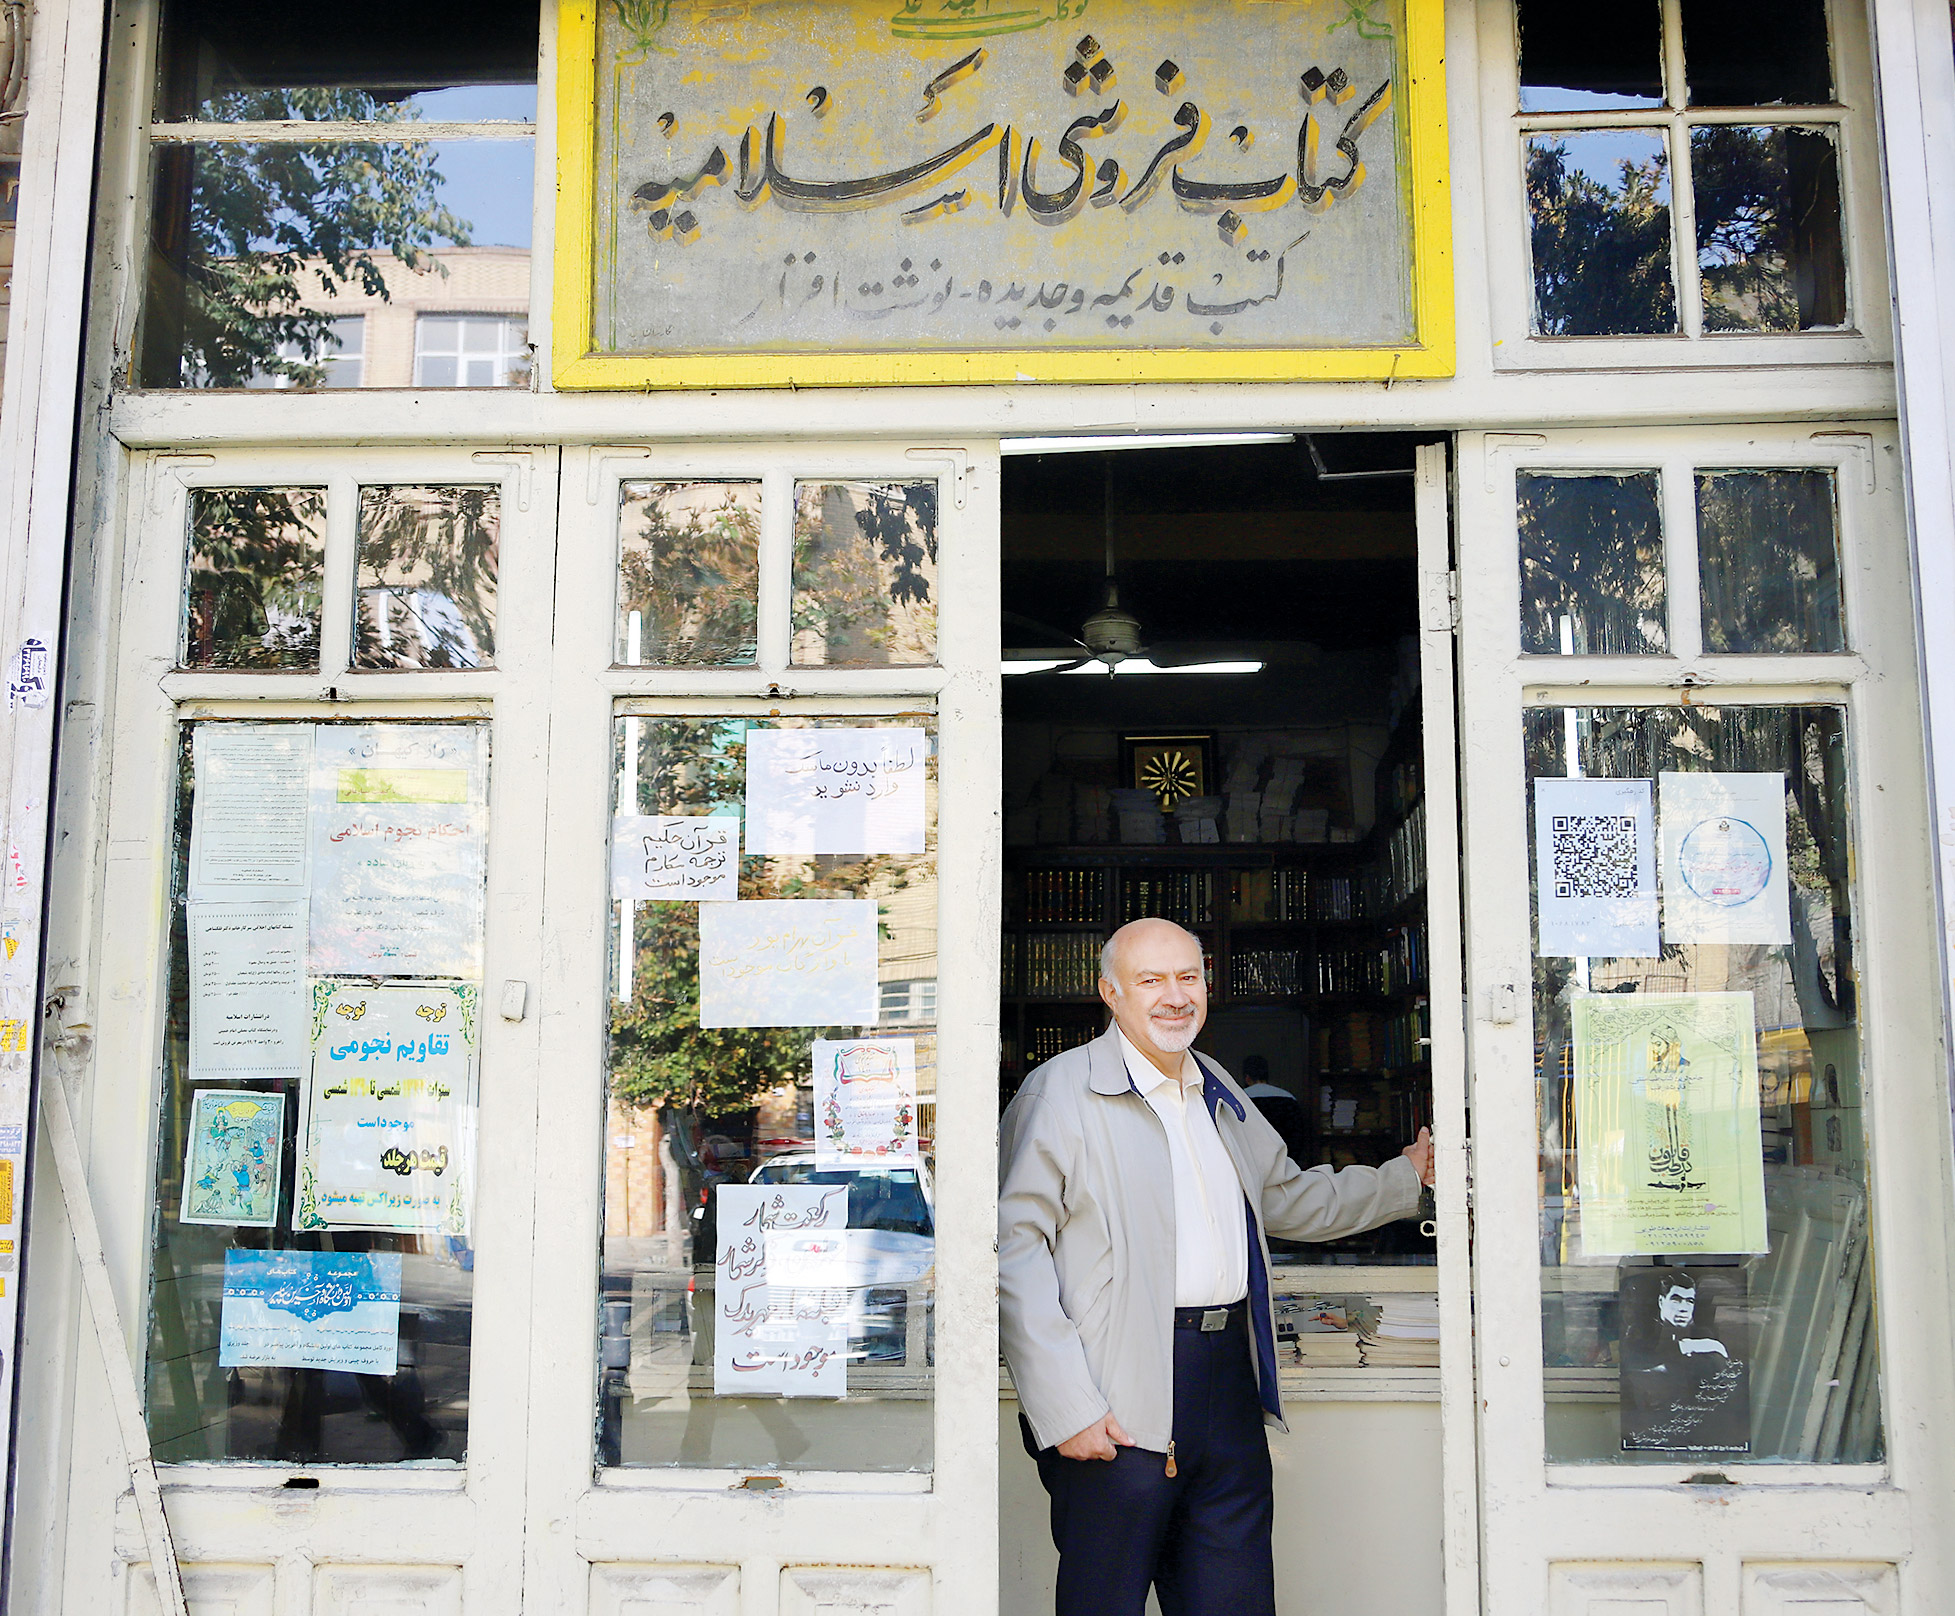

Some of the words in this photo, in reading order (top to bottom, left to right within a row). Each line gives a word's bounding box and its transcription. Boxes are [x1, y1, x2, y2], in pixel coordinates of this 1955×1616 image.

[1021, 34, 1211, 226] فروشی
[628, 86, 1020, 247] اسلامیه
[1173, 66, 1391, 246] کتاب
[736, 251, 841, 324] افزار
[845, 257, 954, 320] نوشت
[1090, 249, 1187, 330] قدیمه
[1186, 230, 1310, 336] کتب
[977, 280, 1068, 332] جدیده
[1066, 286, 1084, 314] و
[785, 749, 832, 774] ماسک
[833, 759, 877, 778] بدون
[881, 746, 914, 775] لطفاً
[810, 779, 861, 799] نشوید
[866, 777, 899, 800] وارد
[330, 822, 379, 842] اسلامی
[384, 824, 422, 842] نجوم
[428, 823, 470, 840] احکام
[643, 821, 684, 856] حکیم
[680, 825, 728, 855] قرآن
[645, 854, 685, 874] مکارم
[689, 851, 726, 870] ترجمه
[644, 873, 685, 888] است
[687, 873, 726, 887] موجود
[812, 917, 858, 952] قرآن
[336, 1001, 366, 1021] توجه
[415, 1003, 447, 1022] توجه
[329, 1031, 392, 1061] نجومی
[396, 1032, 450, 1062] تقاویم
[323, 1079, 348, 1099] شمسی
[369, 1079, 376, 1095] تا
[376, 1080, 401, 1100] شمسی
[381, 1146, 404, 1176] جلد
[404, 1150, 418, 1175] هر
[419, 1146, 448, 1176] قیمت
[321, 1191, 347, 1206] میشود
[350, 1192, 366, 1206] تهیه
[367, 1191, 401, 1207] زیراکس
[772, 1185, 846, 1230] رکعت
[743, 1193, 785, 1234] شمار
[327, 1270, 359, 1278] مجموعه
[789, 1345, 838, 1378] موجود
